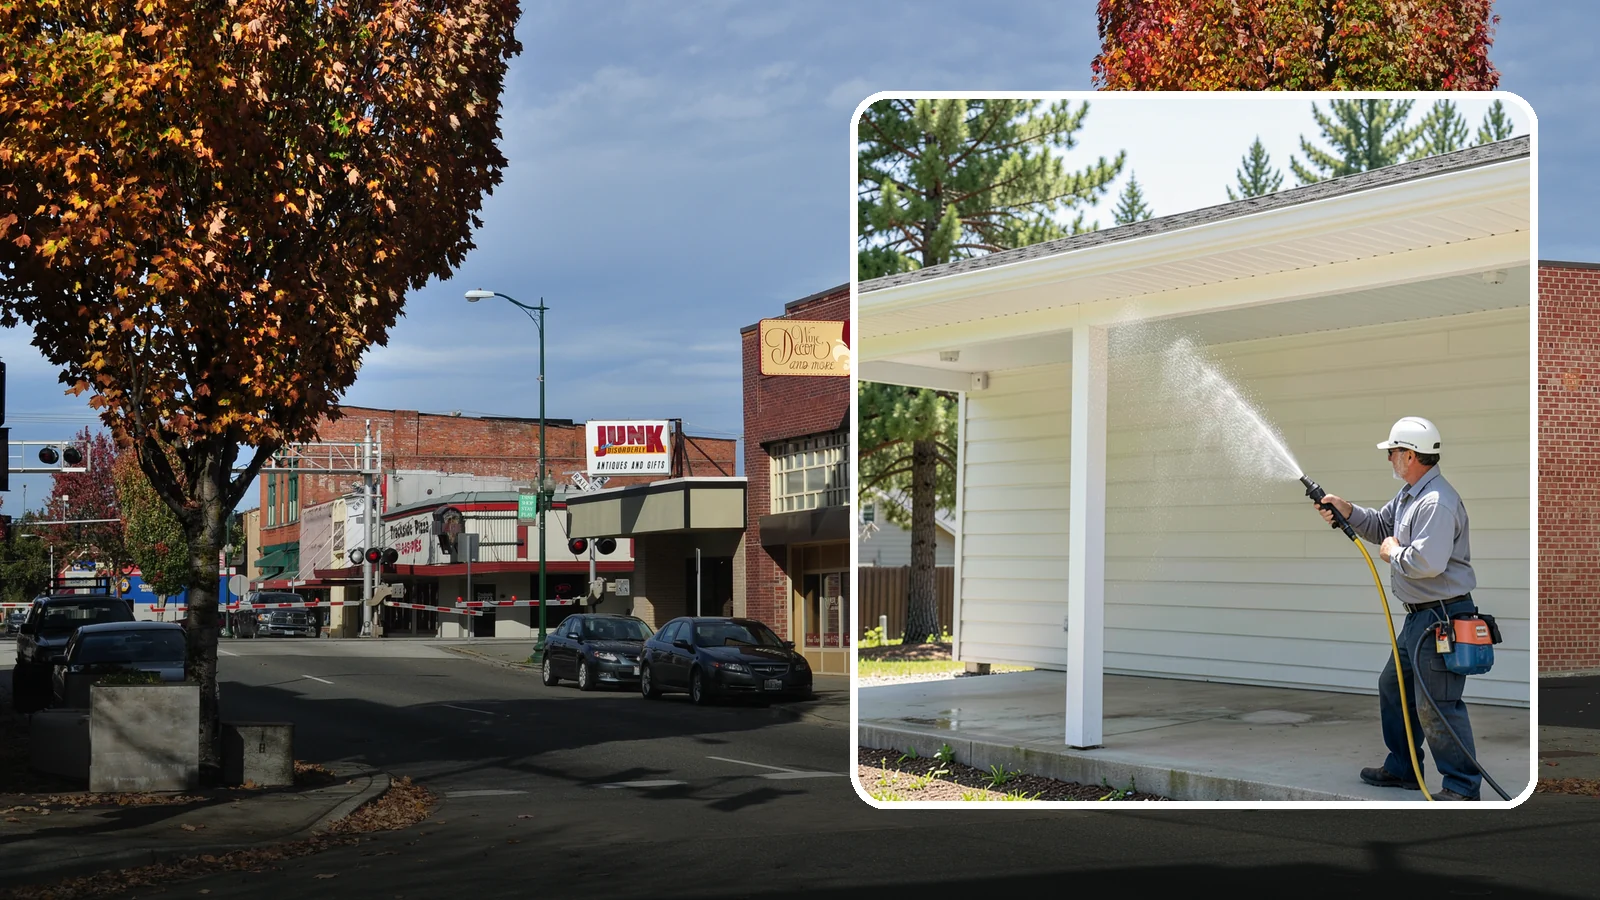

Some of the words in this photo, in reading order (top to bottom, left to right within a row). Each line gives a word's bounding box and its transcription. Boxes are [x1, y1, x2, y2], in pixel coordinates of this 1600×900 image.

[595, 425, 665, 457] JUNK
[607, 446, 646, 454] DISORDERLY
[597, 461, 628, 470] ANTIQUES
[631, 461, 644, 470] AND
[647, 460, 665, 469] GIFTS
[352, 498, 364, 511] CRO
